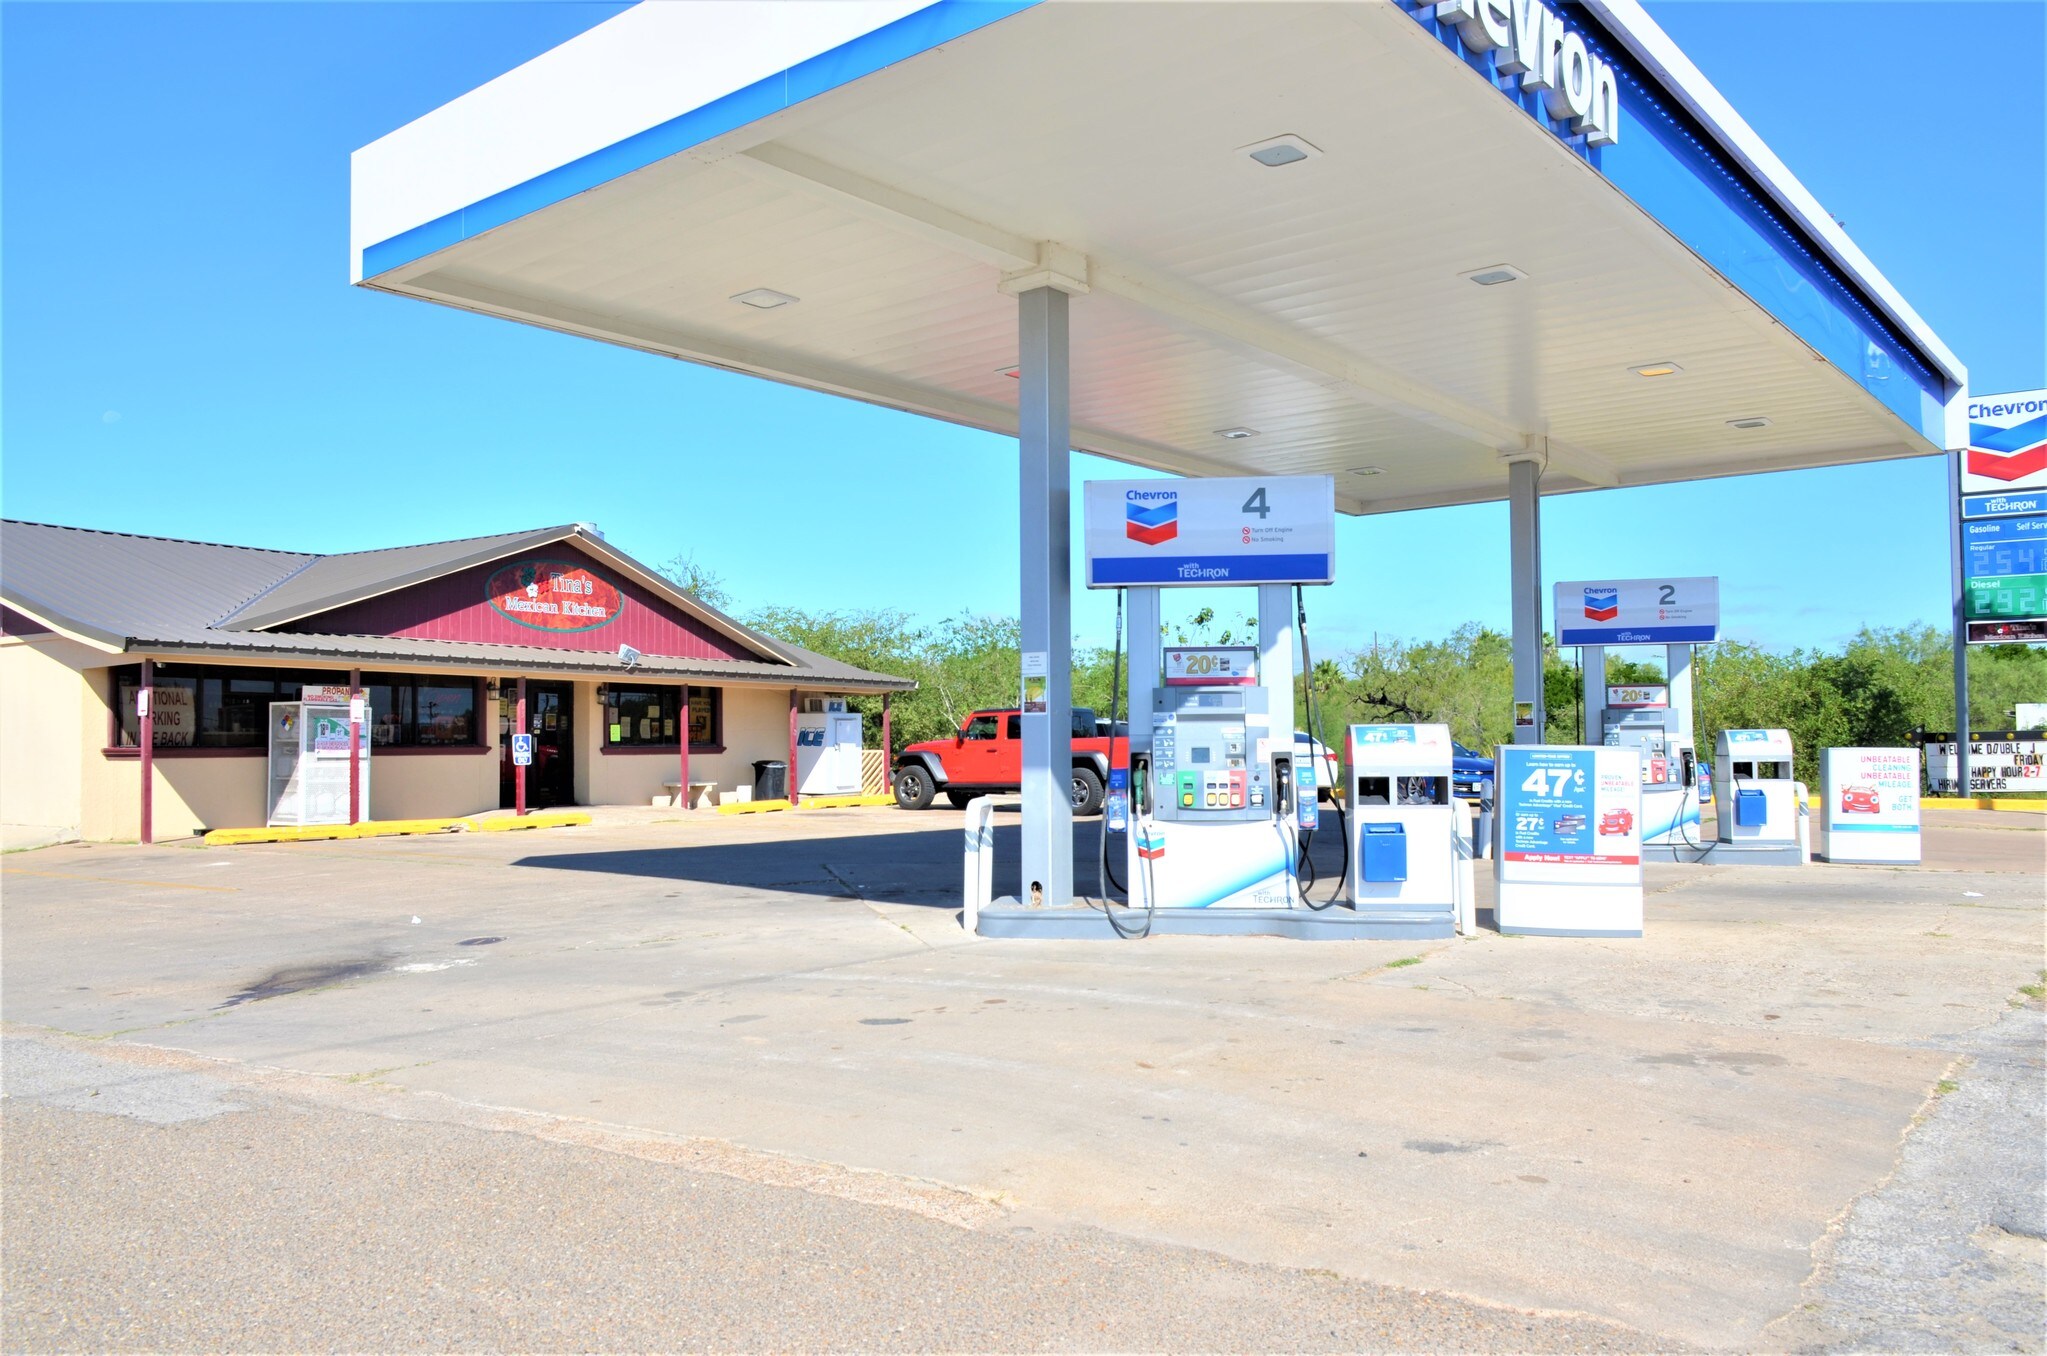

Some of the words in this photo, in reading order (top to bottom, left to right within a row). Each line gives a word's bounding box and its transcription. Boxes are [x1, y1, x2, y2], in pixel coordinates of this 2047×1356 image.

[1418, 0, 1619, 146] evron
[1968, 399, 2047, 419] Chevron
[1126, 489, 1178, 500] Chevron
[1241, 487, 1271, 519] 4
[1984, 500, 2037, 512] TECHRON
[1274, 526, 1293, 534] Engine
[1969, 524, 2000, 534] Gasoline
[2016, 522, 2030, 531] Self
[1261, 536, 1284, 544] Smoking
[1970, 544, 1995, 552] Regular
[1974, 548, 2035, 576] 254
[1177, 567, 1230, 579] TECHRON
[550, 571, 594, 595] Tina's
[1970, 580, 2001, 589] Diesel
[1583, 586, 1617, 594] Chevron
[1658, 584, 1676, 605] 2
[504, 595, 559, 614] Mexican
[561, 600, 607, 618] Kitchen
[1974, 587, 2037, 614] 292
[322, 686, 350, 695] PROPAN
[126, 731, 136, 746] IN
[160, 731, 189, 746] BACK
[797, 726, 826, 747] ICE
[1939, 743, 1983, 756] WELME
[1986, 743, 2020, 754] DOUBLE
[2030, 742, 2035, 754] J
[1861, 772, 1911, 780] UNBEATABLE
[1971, 766, 1997, 778] HAPPY
[2001, 766, 2023, 778] HOUR
[2024, 766, 2041, 778] 2-7
[1938, 779, 1958, 790] HIRIN
[1970, 779, 2007, 790] SERVERS
[1898, 795, 1913, 803] GET
[1524, 854, 1543, 862] Apply
